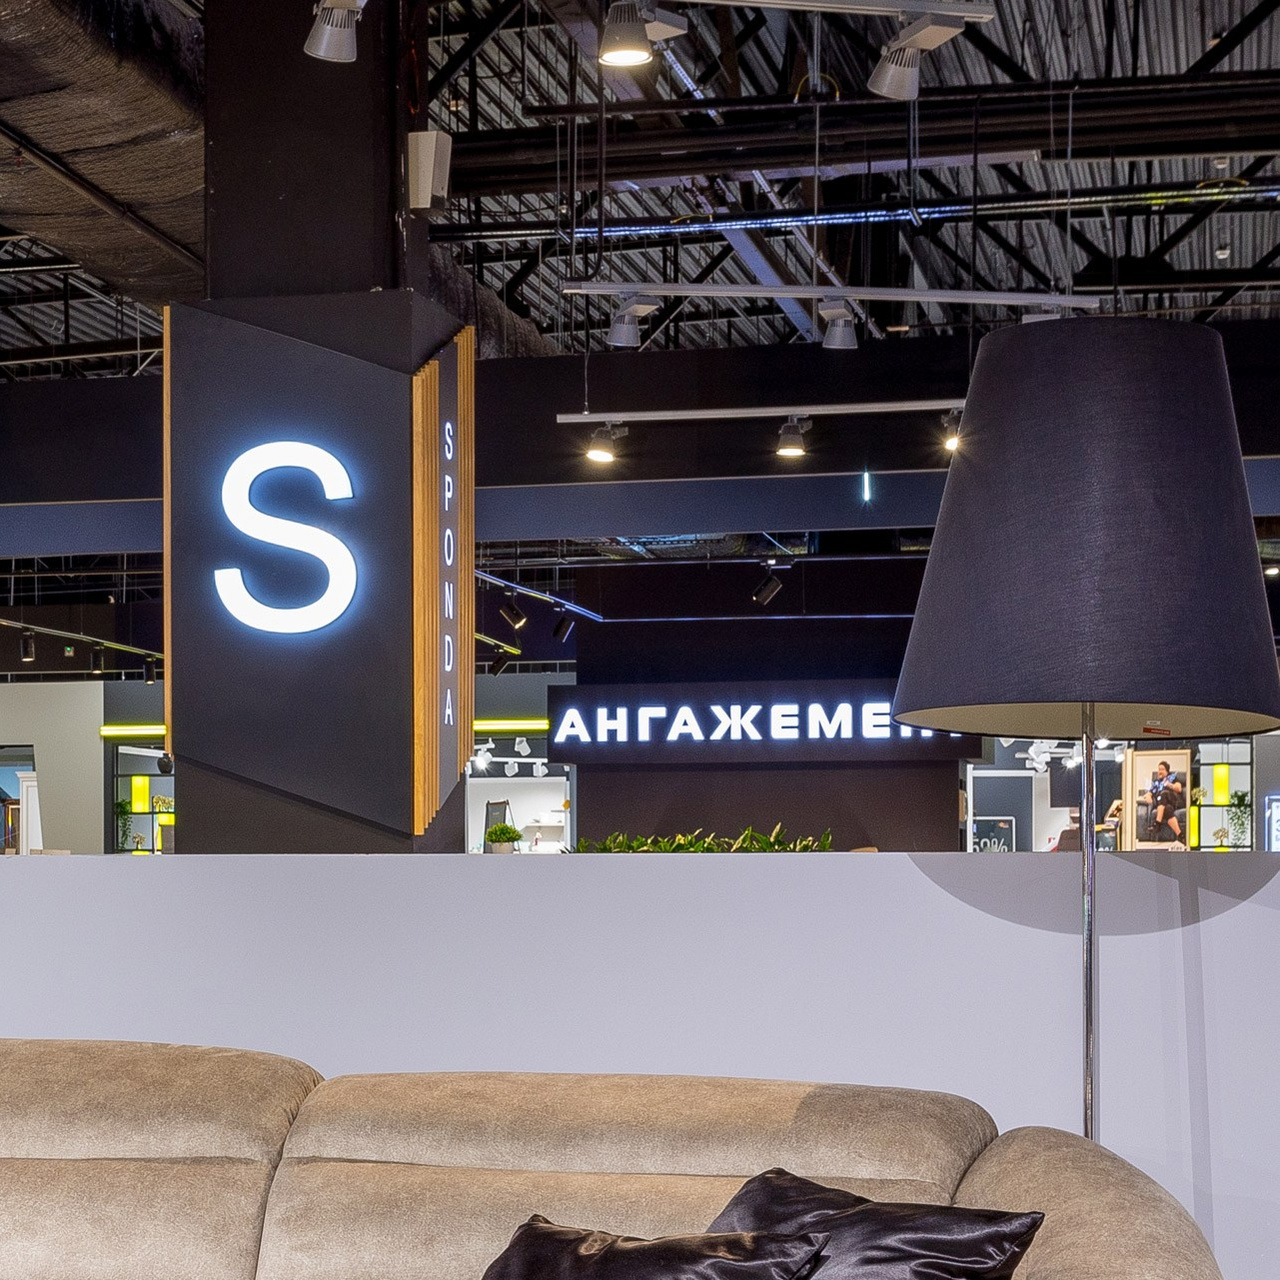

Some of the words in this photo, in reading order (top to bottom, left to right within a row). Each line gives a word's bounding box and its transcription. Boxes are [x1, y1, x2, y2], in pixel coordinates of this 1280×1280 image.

[214, 441, 358, 634] S
[443, 421, 455, 727] SPONDA
[554, 702, 963, 743] АНГАЖЕМЕ
